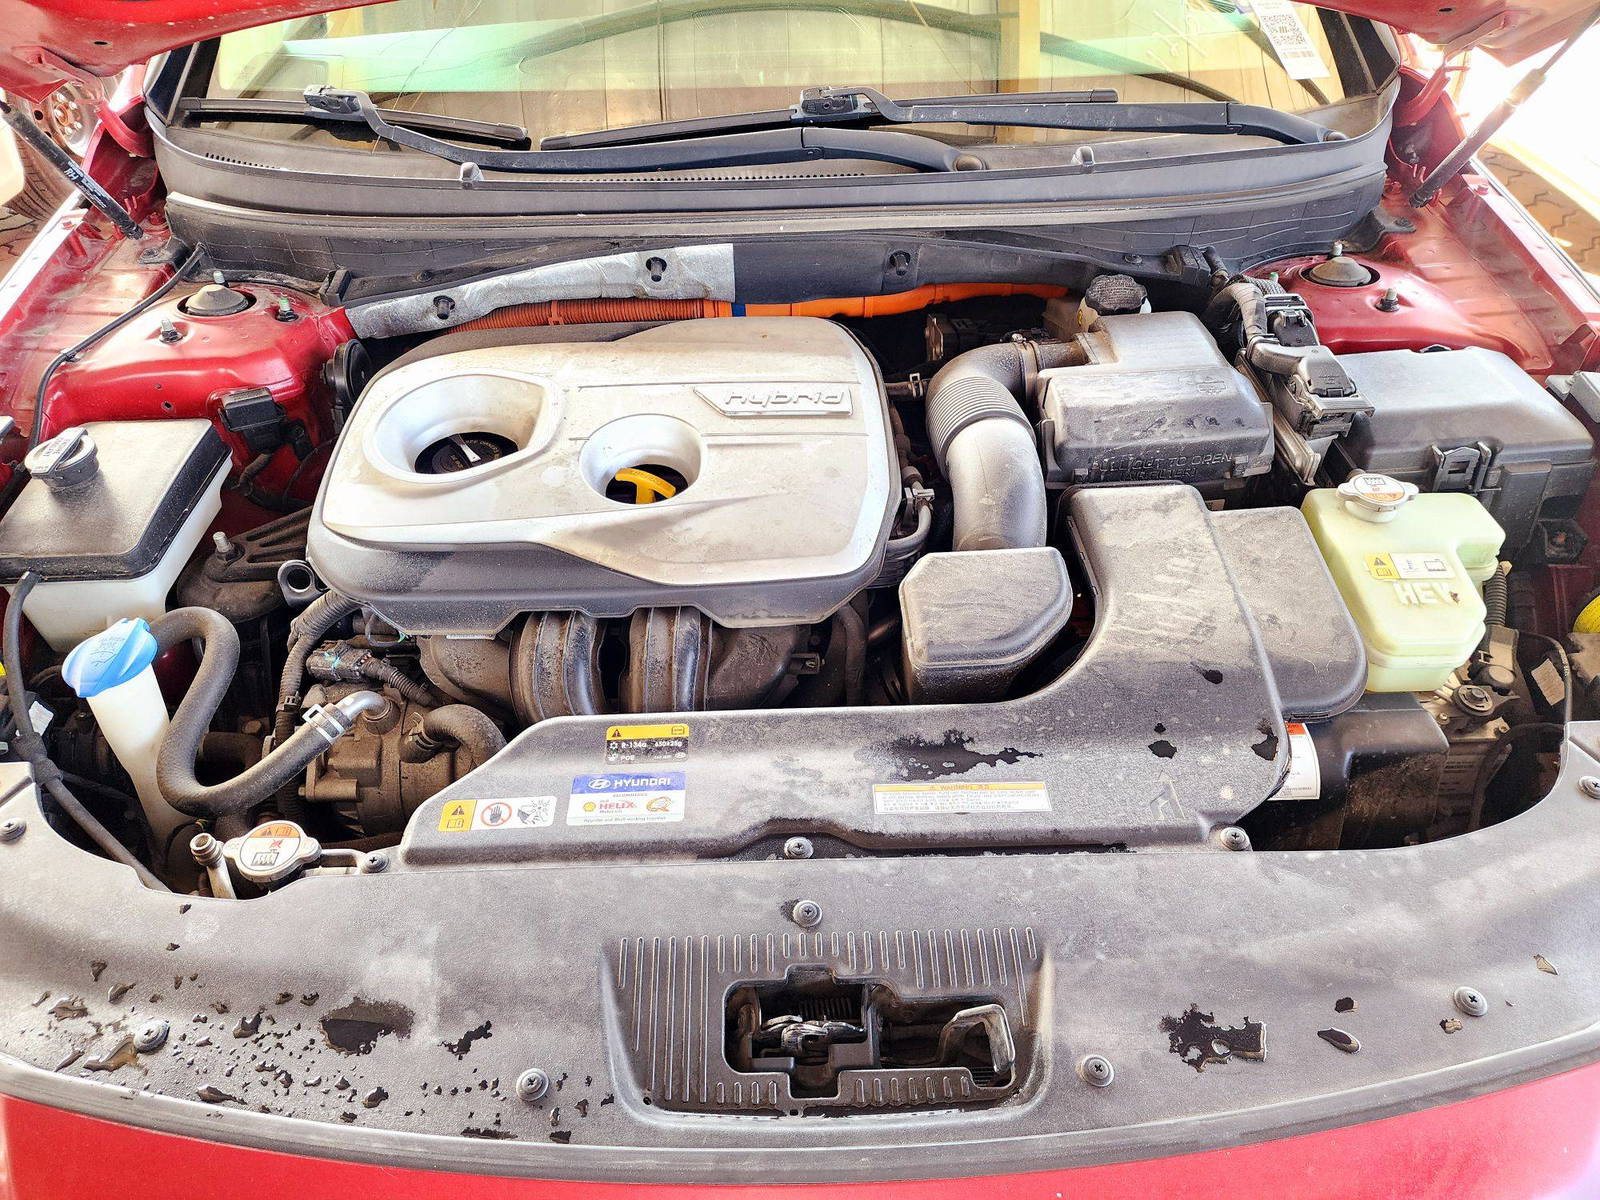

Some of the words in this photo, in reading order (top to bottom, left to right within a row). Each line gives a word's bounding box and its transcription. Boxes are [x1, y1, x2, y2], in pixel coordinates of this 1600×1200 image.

[63, 167, 80, 181] RH
[725, 391, 845, 408] hybrid
[1167, 456, 1188, 467] TO
[1191, 452, 1233, 466] OPEN
[1392, 580, 1458, 606] HEV
[621, 741, 647, 749] R-134a
[613, 777, 671, 789] HYUNDAI
[599, 801, 635, 810] HELIX
